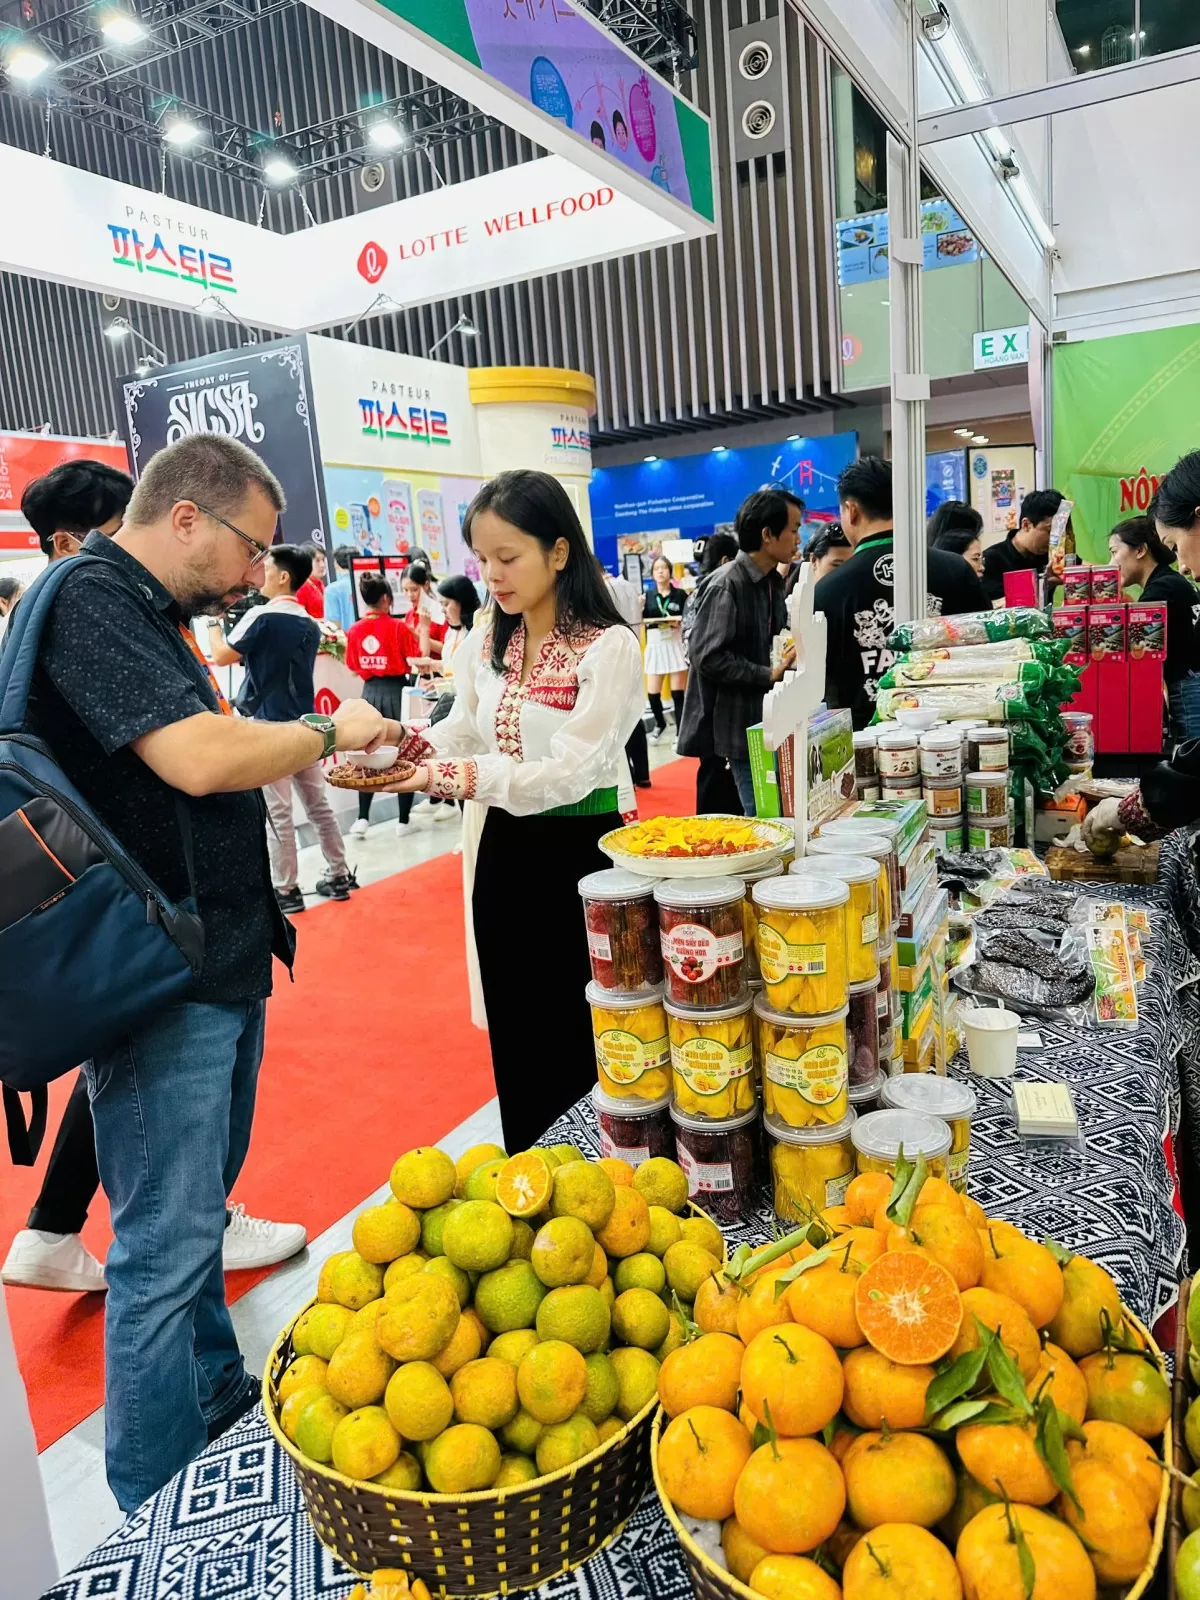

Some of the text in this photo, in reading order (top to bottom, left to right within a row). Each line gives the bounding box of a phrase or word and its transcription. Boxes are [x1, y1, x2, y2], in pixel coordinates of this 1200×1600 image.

[125, 205, 209, 240] PASTEUR
[399, 186, 614, 260] LOTTE WELLFOOD
[107, 223, 237, 294] 파스퇴르
[184, 373, 229, 389] THEORY OF
[372, 380, 432, 401] PASTEUR
[358, 398, 451, 446] 파스퇴르
